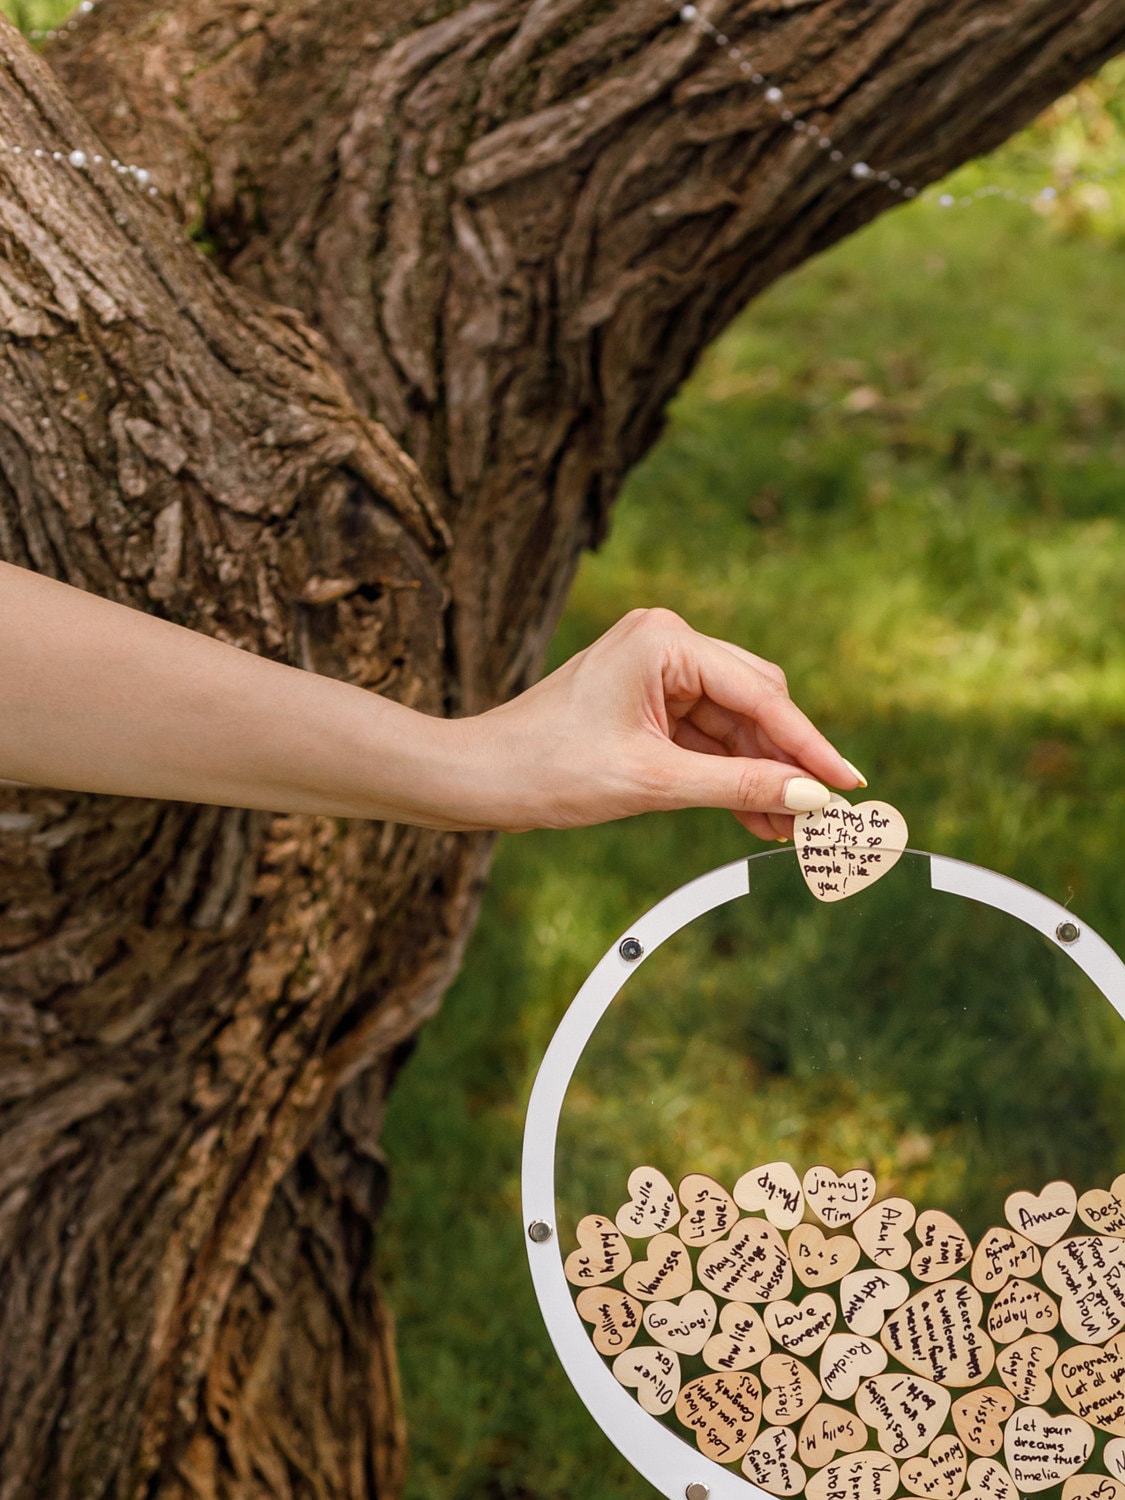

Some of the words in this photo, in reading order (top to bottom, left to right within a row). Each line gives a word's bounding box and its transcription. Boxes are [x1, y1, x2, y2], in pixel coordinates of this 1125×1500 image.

[822, 807, 864, 833] happy
[869, 809, 890, 828] for
[803, 823, 831, 841] you!
[867, 836, 882, 847] so
[802, 845, 837, 860] great
[841, 846, 856, 860] to
[860, 854, 881, 864] see
[803, 861, 842, 878] people
[848, 863, 870, 876] like
[818, 877, 847, 896] you!
[630, 1180, 653, 1225] Estelle
[654, 1193, 675, 1231] Andre
[711, 1196, 728, 1233] love!
[821, 1207, 851, 1222] Tim
[1084, 1194, 1122, 1222] Best
[1018, 1206, 1071, 1230] Anna
[600, 1232, 620, 1273] happy
[704, 1257, 736, 1280] May
[730, 1234, 750, 1262] your
[917, 1255, 932, 1275] We
[925, 1224, 936, 1247] are
[935, 1241, 950, 1265] love
[948, 1234, 967, 1265] you!
[637, 1250, 682, 1295] Vanessa
[748, 1270, 764, 1284] be
[756, 1245, 791, 1300] blessed!
[649, 1313, 668, 1329] Go
[668, 1309, 711, 1337] enjoy!
[774, 1307, 817, 1329] Love
[782, 1312, 831, 1348] forever
[729, 1319, 754, 1342] life
[1002, 1351, 1023, 1378] day
[1017, 1346, 1042, 1401] Wedding
[634, 1364, 673, 1404] Oliver
[822, 1420, 855, 1440] Sally
[1015, 1417, 1036, 1432] Let
[1043, 1427, 1072, 1438] your
[1013, 1453, 1049, 1463] come
[1052, 1444, 1088, 1464] true!
[1014, 1437, 1065, 1452] dreams
[979, 1467, 996, 1490] you
[1014, 1468, 1060, 1481] Amelia
